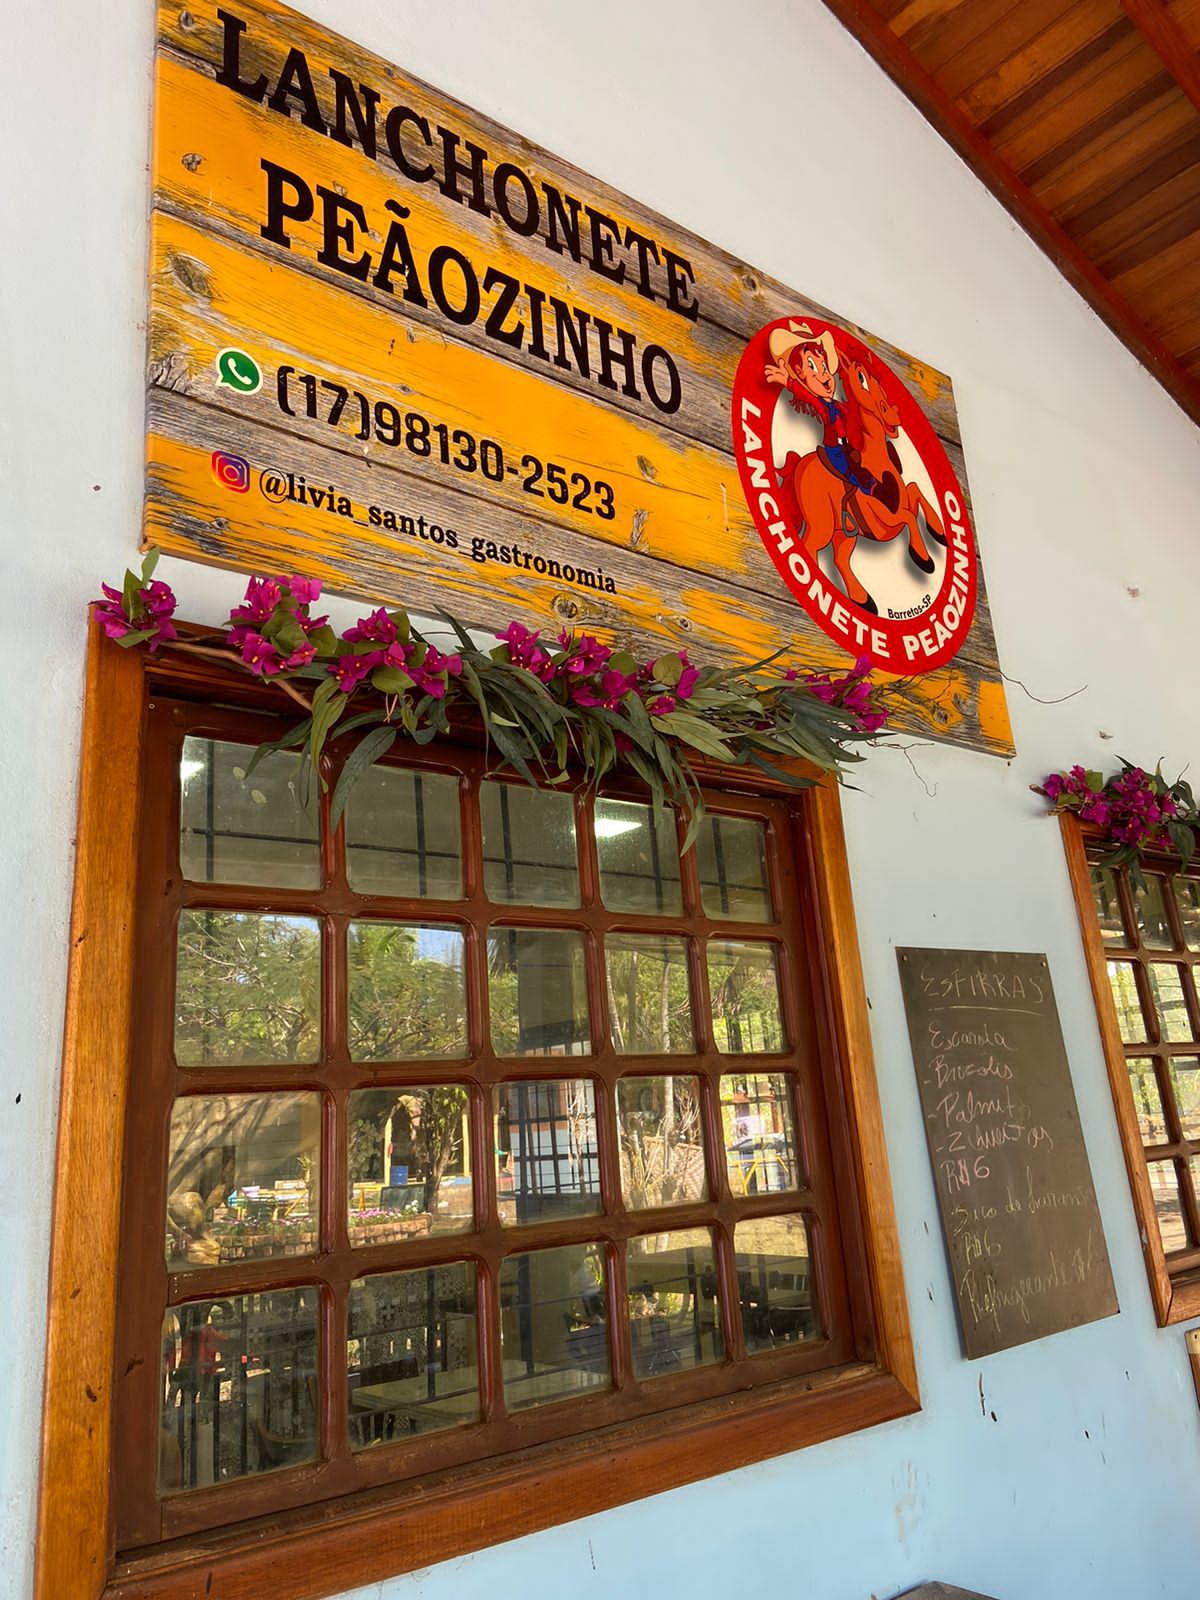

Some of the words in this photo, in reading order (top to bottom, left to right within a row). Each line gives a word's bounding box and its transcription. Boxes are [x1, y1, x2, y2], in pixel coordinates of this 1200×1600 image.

[217, 8, 700, 322] LANCHONETE
[260, 158, 682, 415] PEÃOZINHO
[260, 467, 618, 595] @livia_santos_gastronomia
[277, 365, 616, 521] (17)98130-2523
[742, 397, 890, 659] LANCHONETE
[903, 490, 969, 661] PEÃOZINHO
[887, 594, 931, 619] Barretos-SP
